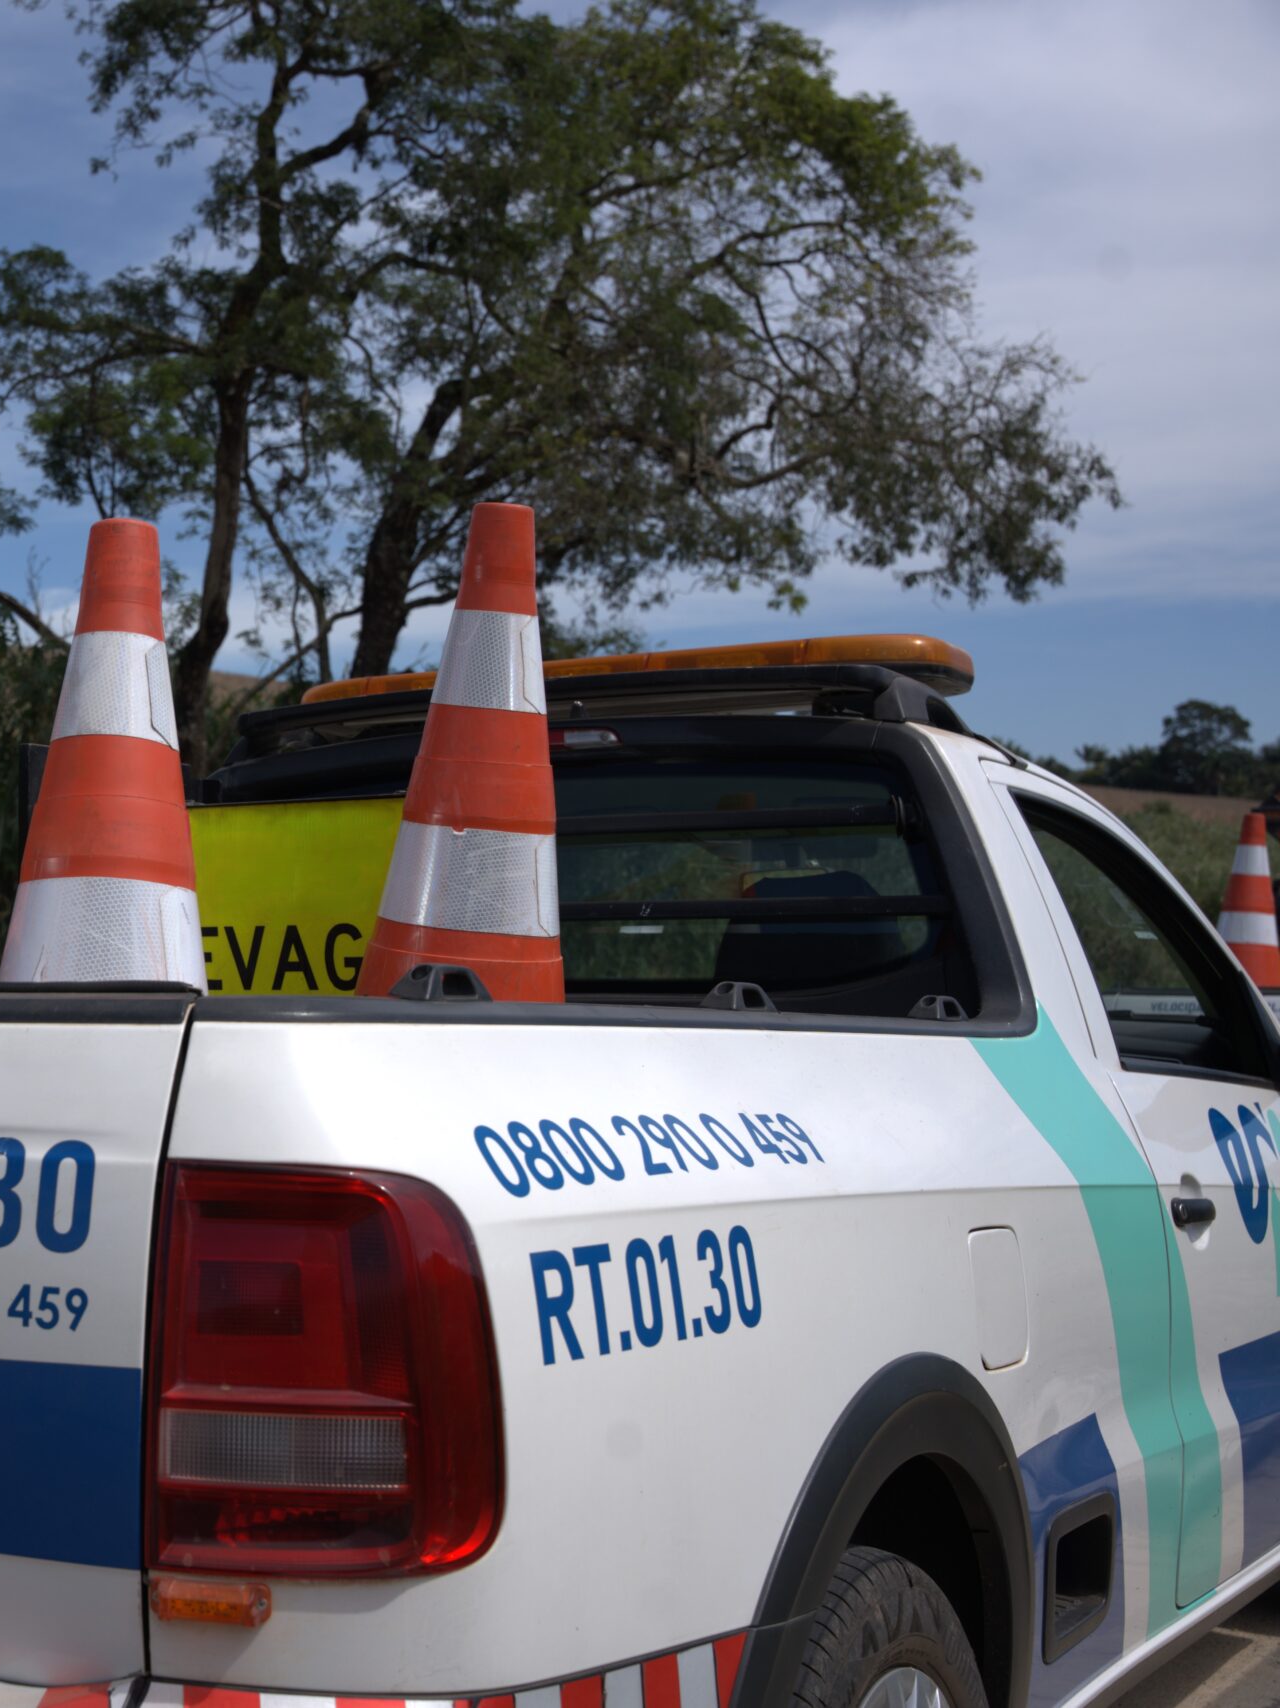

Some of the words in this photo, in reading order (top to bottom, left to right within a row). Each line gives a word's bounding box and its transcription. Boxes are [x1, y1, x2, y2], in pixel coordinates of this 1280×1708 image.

[473, 1117, 626, 1198] 0800
[611, 1113, 719, 1176] 290
[698, 1112, 755, 1168] 0
[737, 1112, 825, 1165] 459
[7, 1283, 89, 1332] 459
[529, 1224, 762, 1366] RT.01.30
